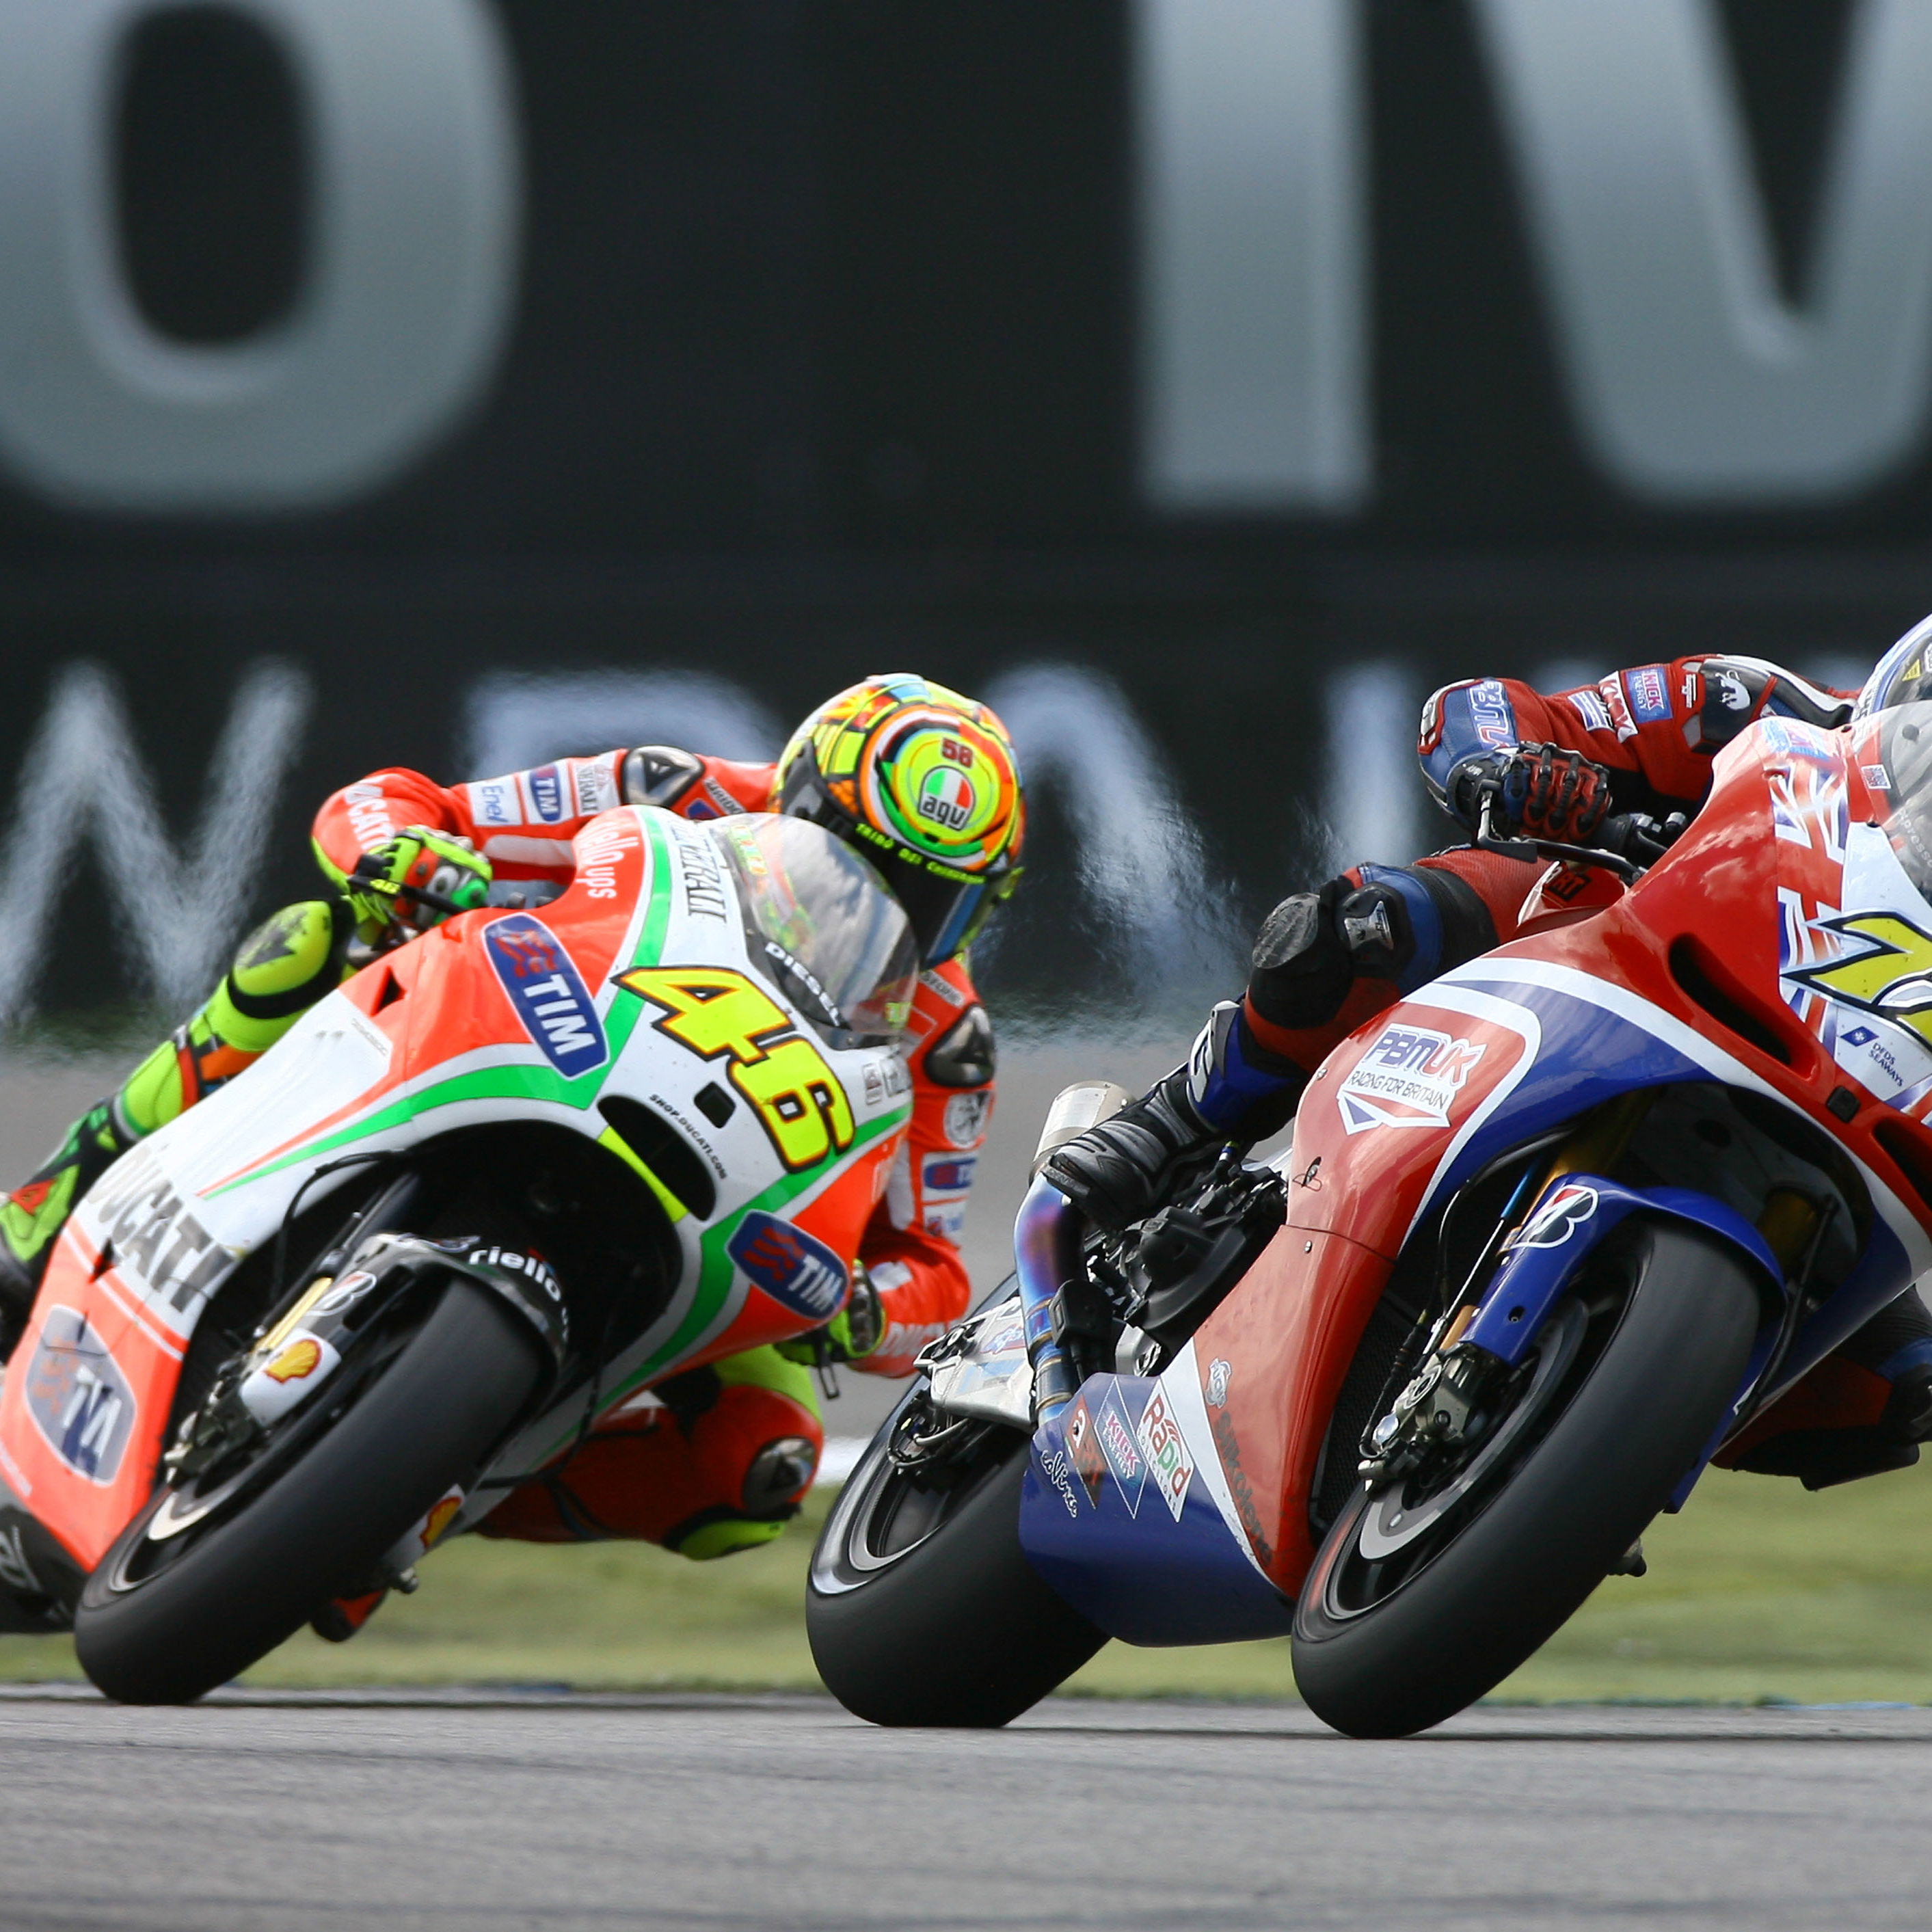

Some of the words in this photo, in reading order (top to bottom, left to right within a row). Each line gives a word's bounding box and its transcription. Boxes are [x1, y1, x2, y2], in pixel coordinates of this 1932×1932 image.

[1641, 671, 1664, 711] KICK
[941, 737, 974, 768] 58
[535, 777, 561, 815] TIM
[922, 795, 966, 824] agv
[576, 866, 617, 899] ups
[523, 973, 596, 1056] TIM
[610, 964, 856, 1175] 46
[1868, 1049, 1903, 1087] SEAWAYS
[1873, 1043, 1896, 1065] DFDS
[1347, 1071, 1385, 1089] RACING
[1378, 1075, 1407, 1095] FOR
[1401, 1078, 1449, 1110] BRITAIN
[468, 1246, 562, 1302] riello
[787, 1253, 844, 1311] TIM
[1105, 1410, 1142, 1471] KICK
[1142, 1393, 1192, 1497] Rapid
